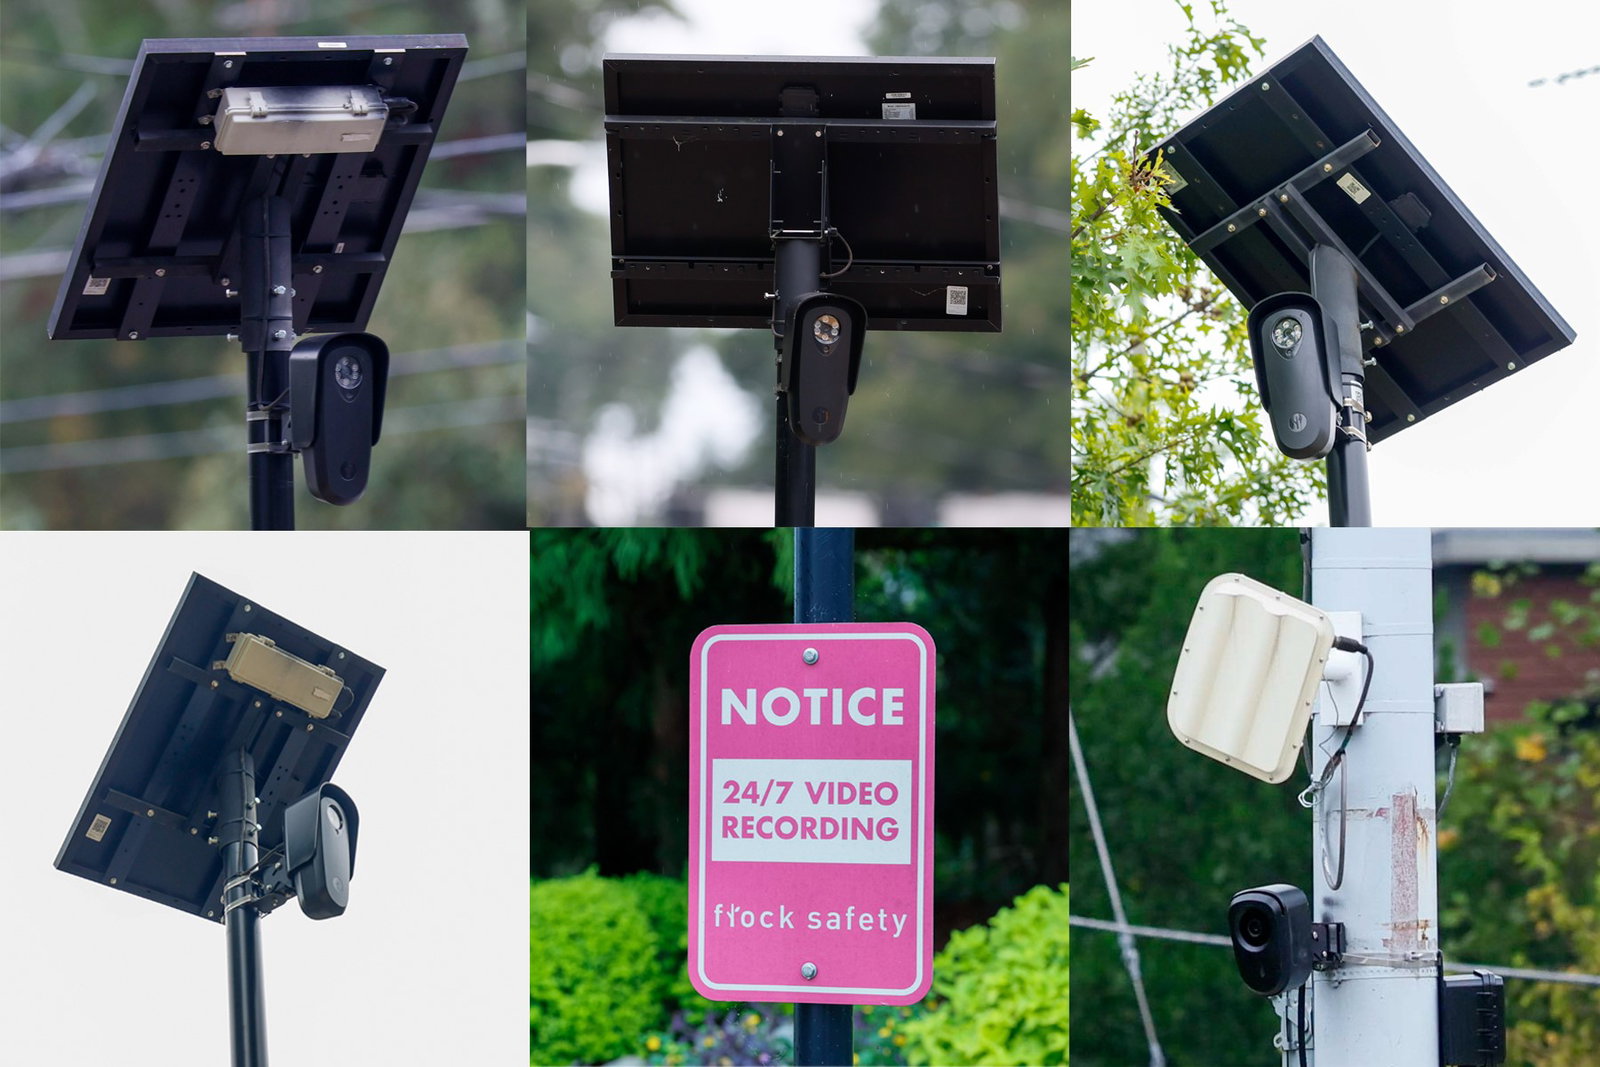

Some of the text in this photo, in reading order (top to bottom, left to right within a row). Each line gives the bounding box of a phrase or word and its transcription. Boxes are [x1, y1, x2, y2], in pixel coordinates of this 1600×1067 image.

[721, 686, 904, 726] NOTICE
[722, 779, 899, 807] 24/7 VIDEO
[721, 815, 900, 842] RECORDING
[713, 903, 907, 938] flock safety
